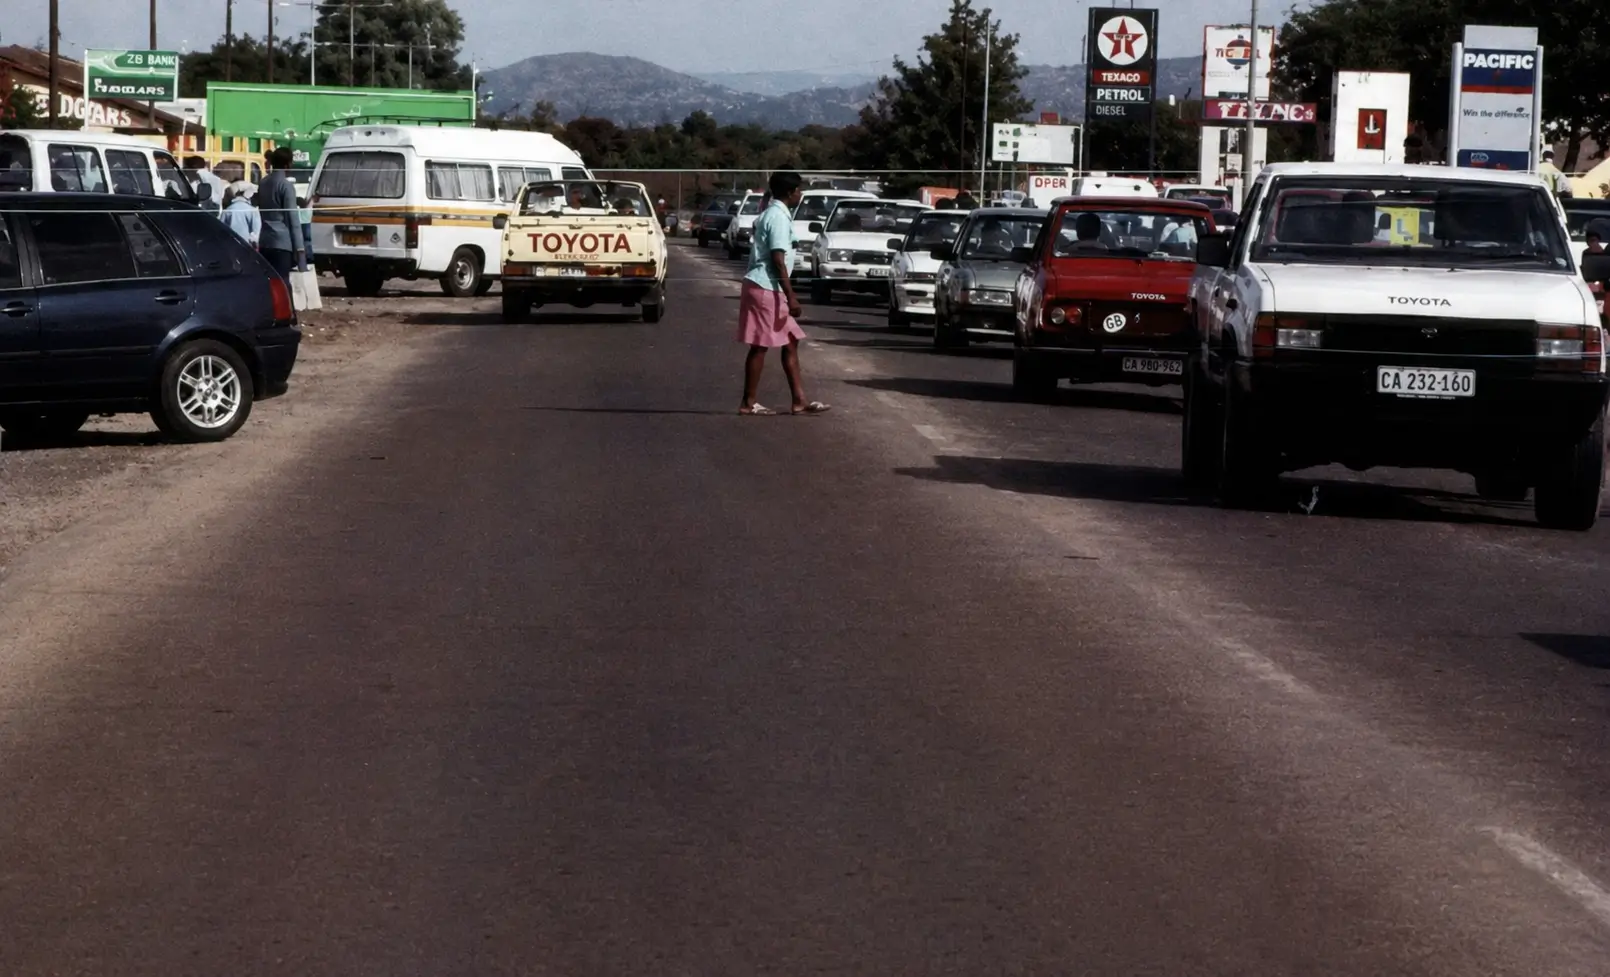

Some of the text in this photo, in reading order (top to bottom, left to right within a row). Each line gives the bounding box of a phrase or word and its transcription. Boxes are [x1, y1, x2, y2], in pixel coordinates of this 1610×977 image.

[148, 54, 175, 66] BANK
[1463, 53, 1534, 69] PACIFIC
[1101, 72, 1141, 83] TEXACO
[1096, 88, 1145, 101] PETROL
[1095, 105, 1127, 116] DIESEL
[1463, 108, 1478, 117] Win
[1480, 109, 1493, 117] the
[527, 232, 632, 253] TOYOTA
[1130, 292, 1166, 301] TOYOTA
[1388, 296, 1452, 307] TOYOTA
[1106, 314, 1123, 329] GB
[1124, 359, 1182, 374] CA 980-962
[1381, 371, 1471, 393] CA 232-160
